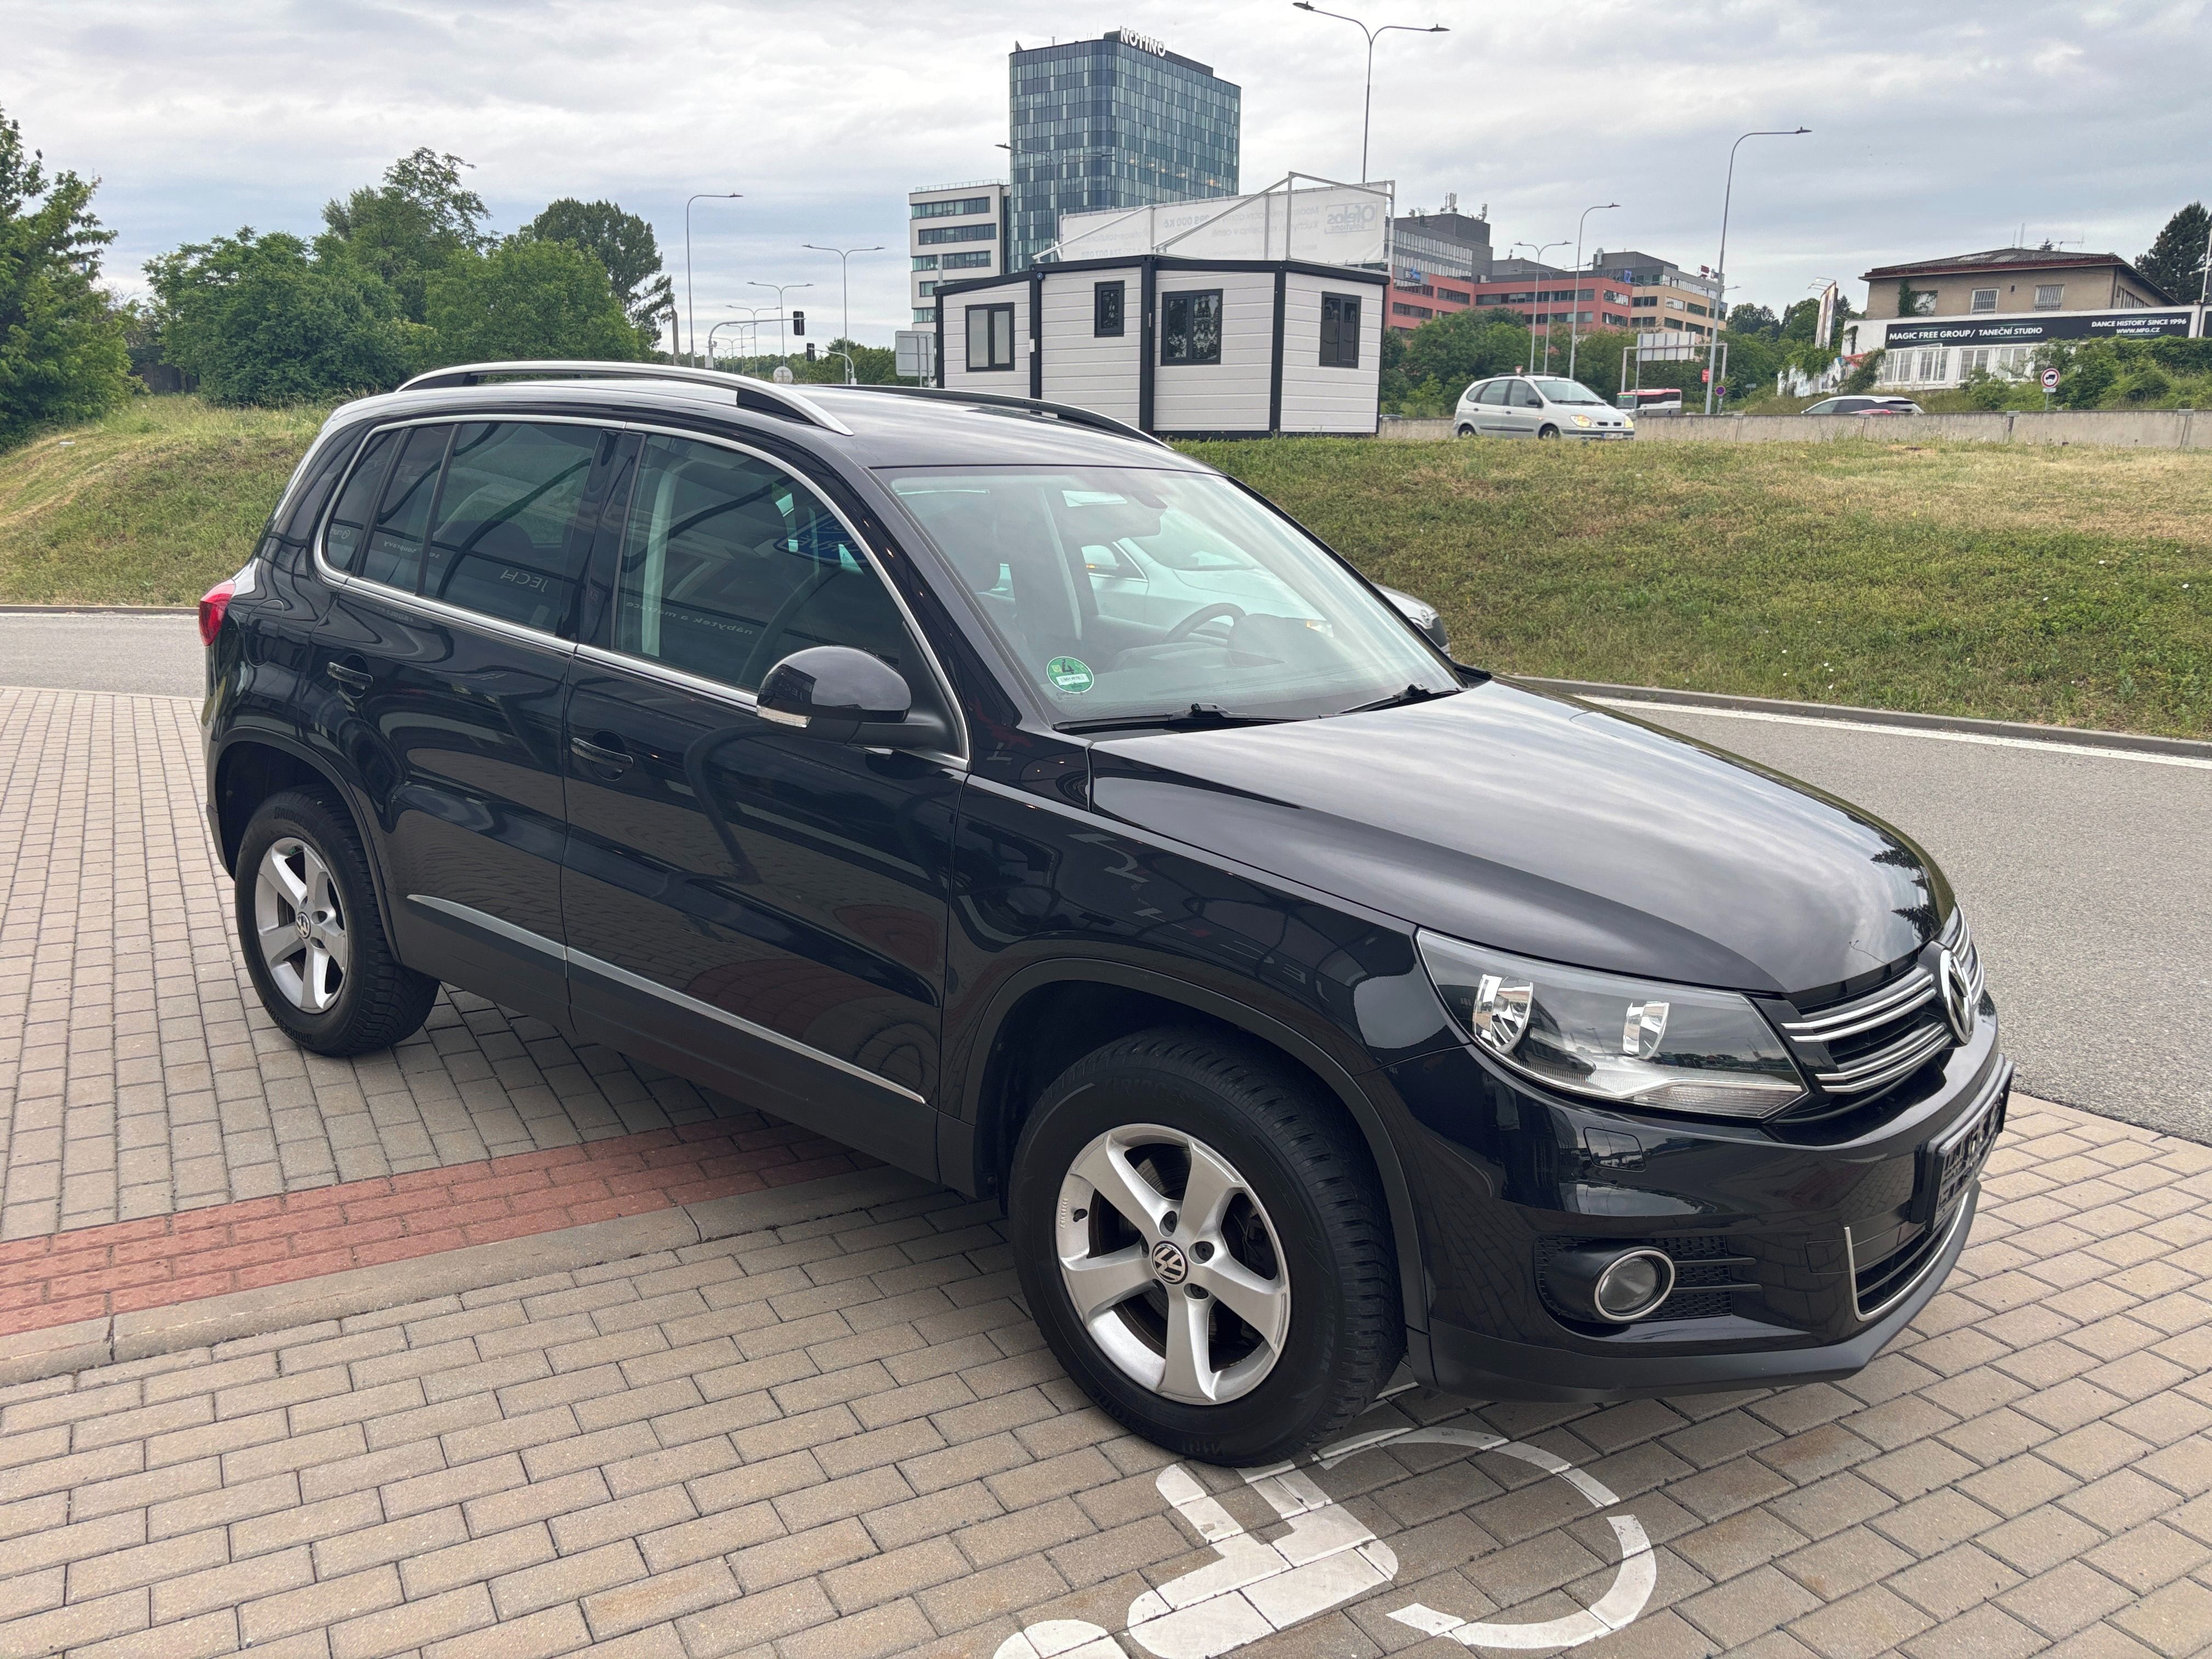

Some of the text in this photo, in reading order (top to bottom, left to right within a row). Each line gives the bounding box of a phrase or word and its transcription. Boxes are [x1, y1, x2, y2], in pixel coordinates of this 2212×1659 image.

[1120, 26, 1166, 57] NOTINO
[1889, 326, 2043, 340] MAGIC FREE GROUP/ TANEČNÍ STUDIO
[1062, 658, 1074, 674] 4
